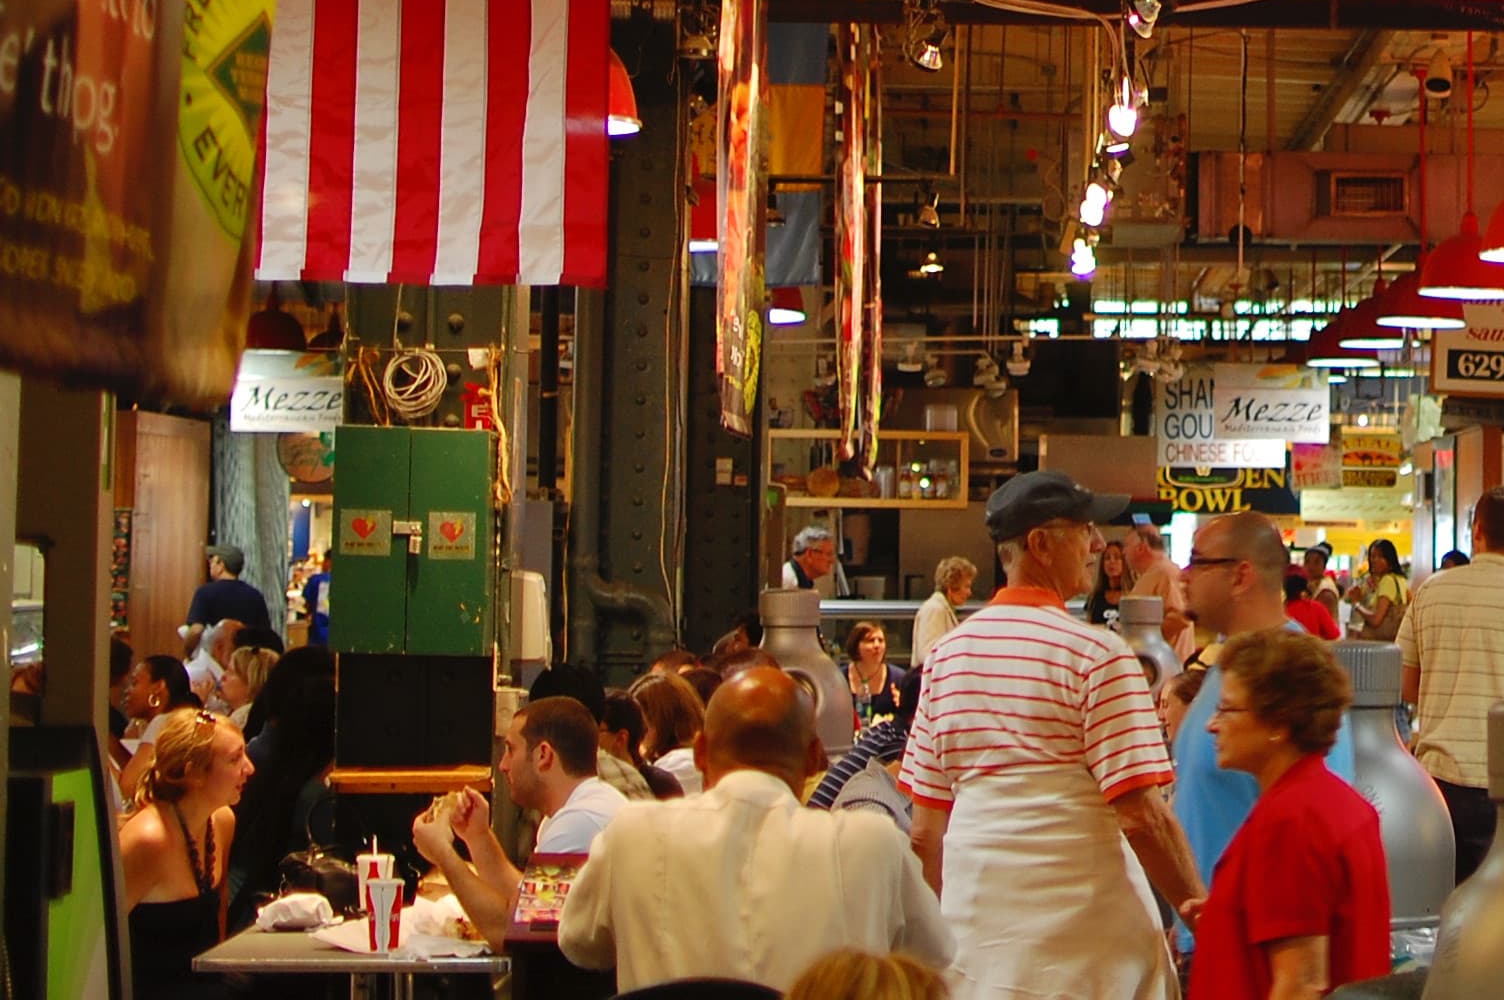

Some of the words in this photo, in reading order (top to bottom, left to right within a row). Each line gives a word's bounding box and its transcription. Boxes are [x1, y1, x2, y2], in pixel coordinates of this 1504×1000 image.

[242, 386, 342, 412] Mezze
[1221, 396, 1322, 423] Mezze
[1166, 443, 1227, 463] CHINESE
[1159, 487, 1250, 513] BOWL
